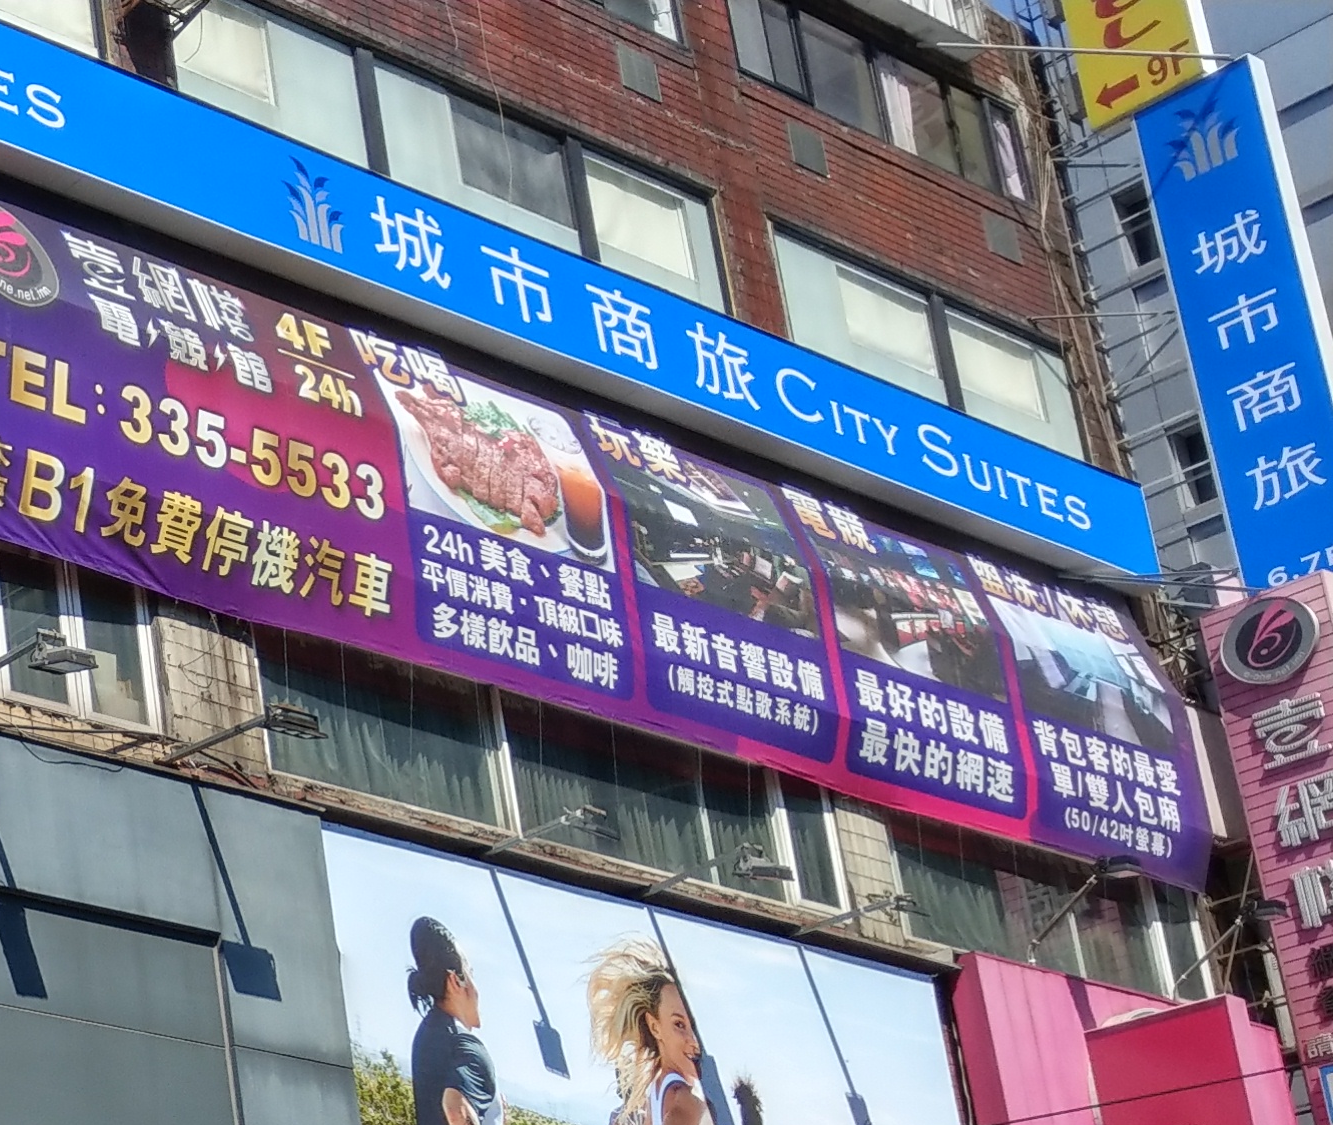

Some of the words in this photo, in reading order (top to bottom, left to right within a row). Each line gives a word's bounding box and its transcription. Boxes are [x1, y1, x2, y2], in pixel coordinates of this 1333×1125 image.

[276, 312, 332, 359] 4F
[371, 196, 760, 411] 城市商旅
[294, 365, 364, 419] 24h
[348, 328, 464, 403] 吃喝
[1191, 209, 1328, 511] 城市商旅
[120, 386, 385, 521] 335-5533
[583, 411, 688, 484] 玩樂
[423, 524, 474, 566] 24h
[780, 483, 877, 555] 電競
[651, 612, 825, 702] 最新音響設備
[855, 669, 1010, 756] 最好的設備
[860, 717, 1015, 804] 最快的網速
[1033, 719, 1181, 797] 背包客的最愛
